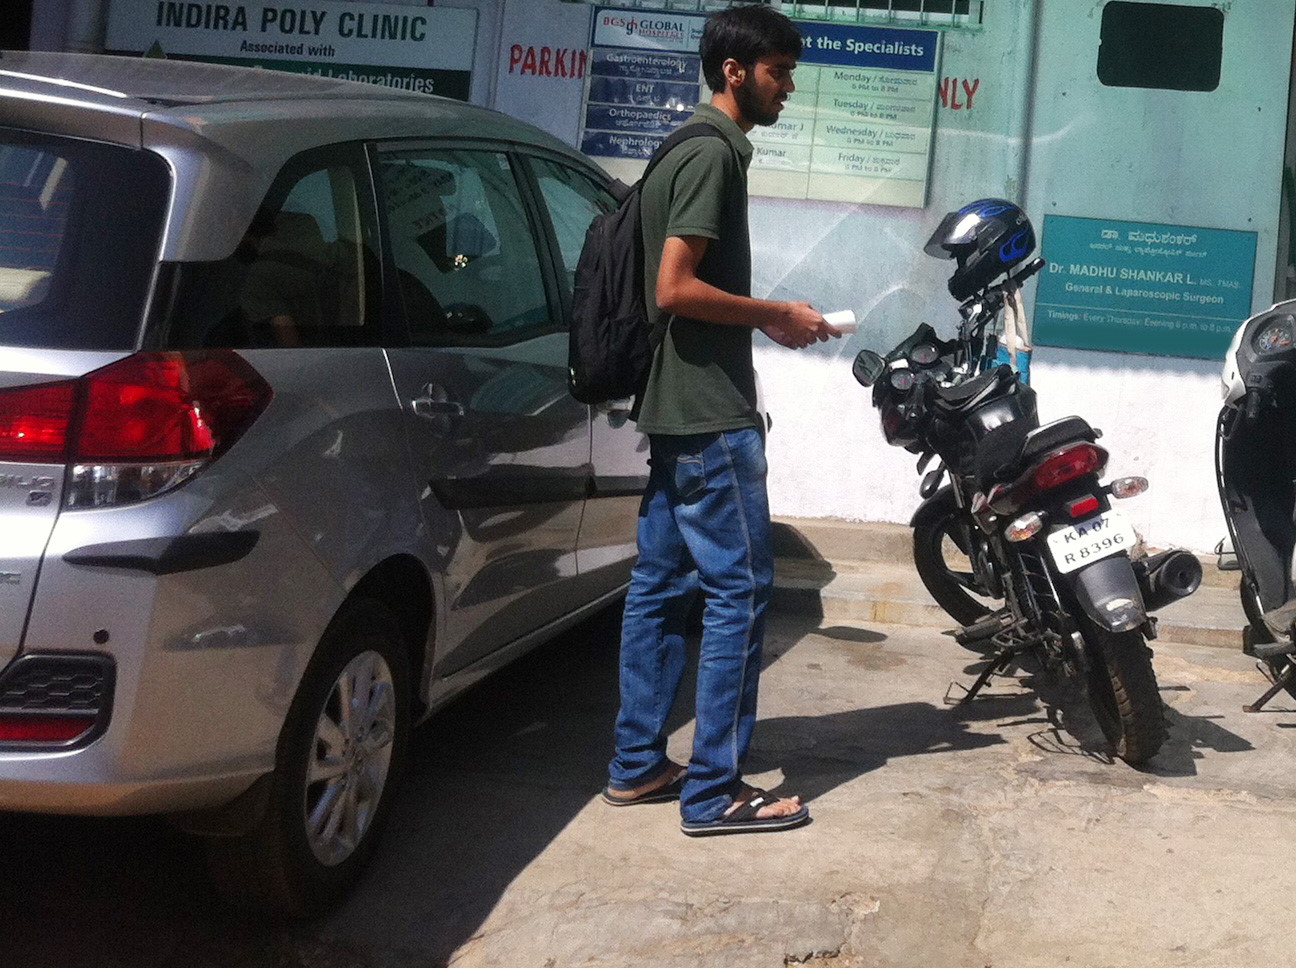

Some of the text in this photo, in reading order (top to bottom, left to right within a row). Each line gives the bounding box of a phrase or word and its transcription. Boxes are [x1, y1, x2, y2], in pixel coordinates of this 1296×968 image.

[156, 0, 427, 42] INDIRA POLY CLINIC
[640, 19, 684, 32] GLOBAL
[240, 40, 335, 57] Associated with
[817, 36, 841, 50] the
[846, 39, 924, 57] Specialists
[834, 72, 870, 83] Monday
[636, 84, 655, 92] ENT
[833, 98, 868, 111] Tuesday
[609, 108, 671, 122] Orthopaedics
[827, 125, 877, 139] Wednesday
[756, 147, 787, 157] Kumar
[838, 152, 865, 164] Friday
[1050, 263, 1064, 274] Dr.
[1069, 264, 1117, 278] MADHU
[1119, 269, 1183, 284] SHANKAR
[1065, 282, 1224, 304] General & Laparoscopic Surgeon
[1064, 527, 1089, 543] KA
[1064, 533, 1124, 564] R 8396
